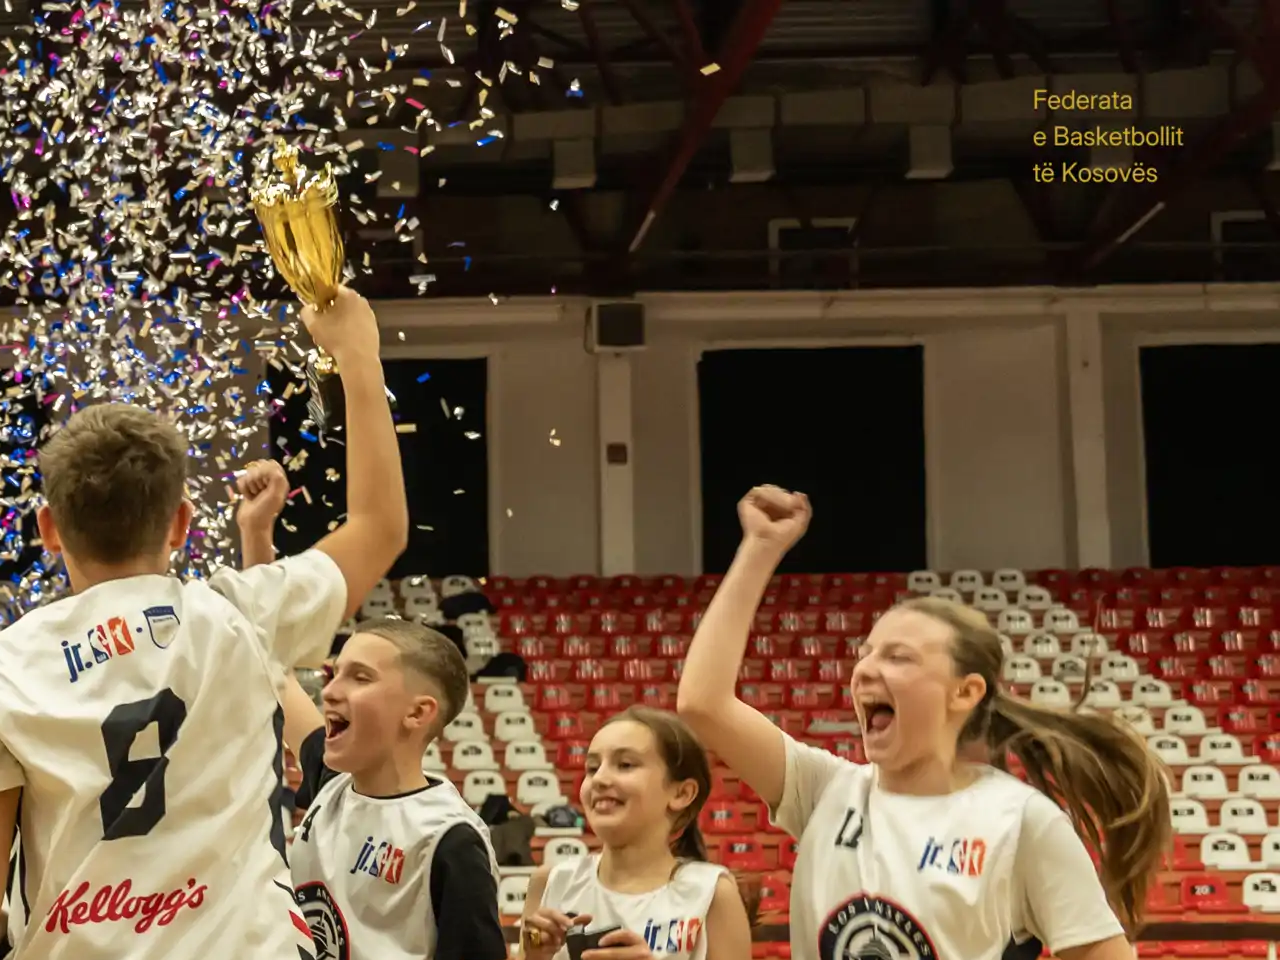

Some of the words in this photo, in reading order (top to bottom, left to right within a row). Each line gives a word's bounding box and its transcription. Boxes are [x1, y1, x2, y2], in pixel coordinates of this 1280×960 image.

[61, 640, 93, 683] jr.
[100, 687, 187, 841] 8
[45, 877, 208, 934] Kellogg's
